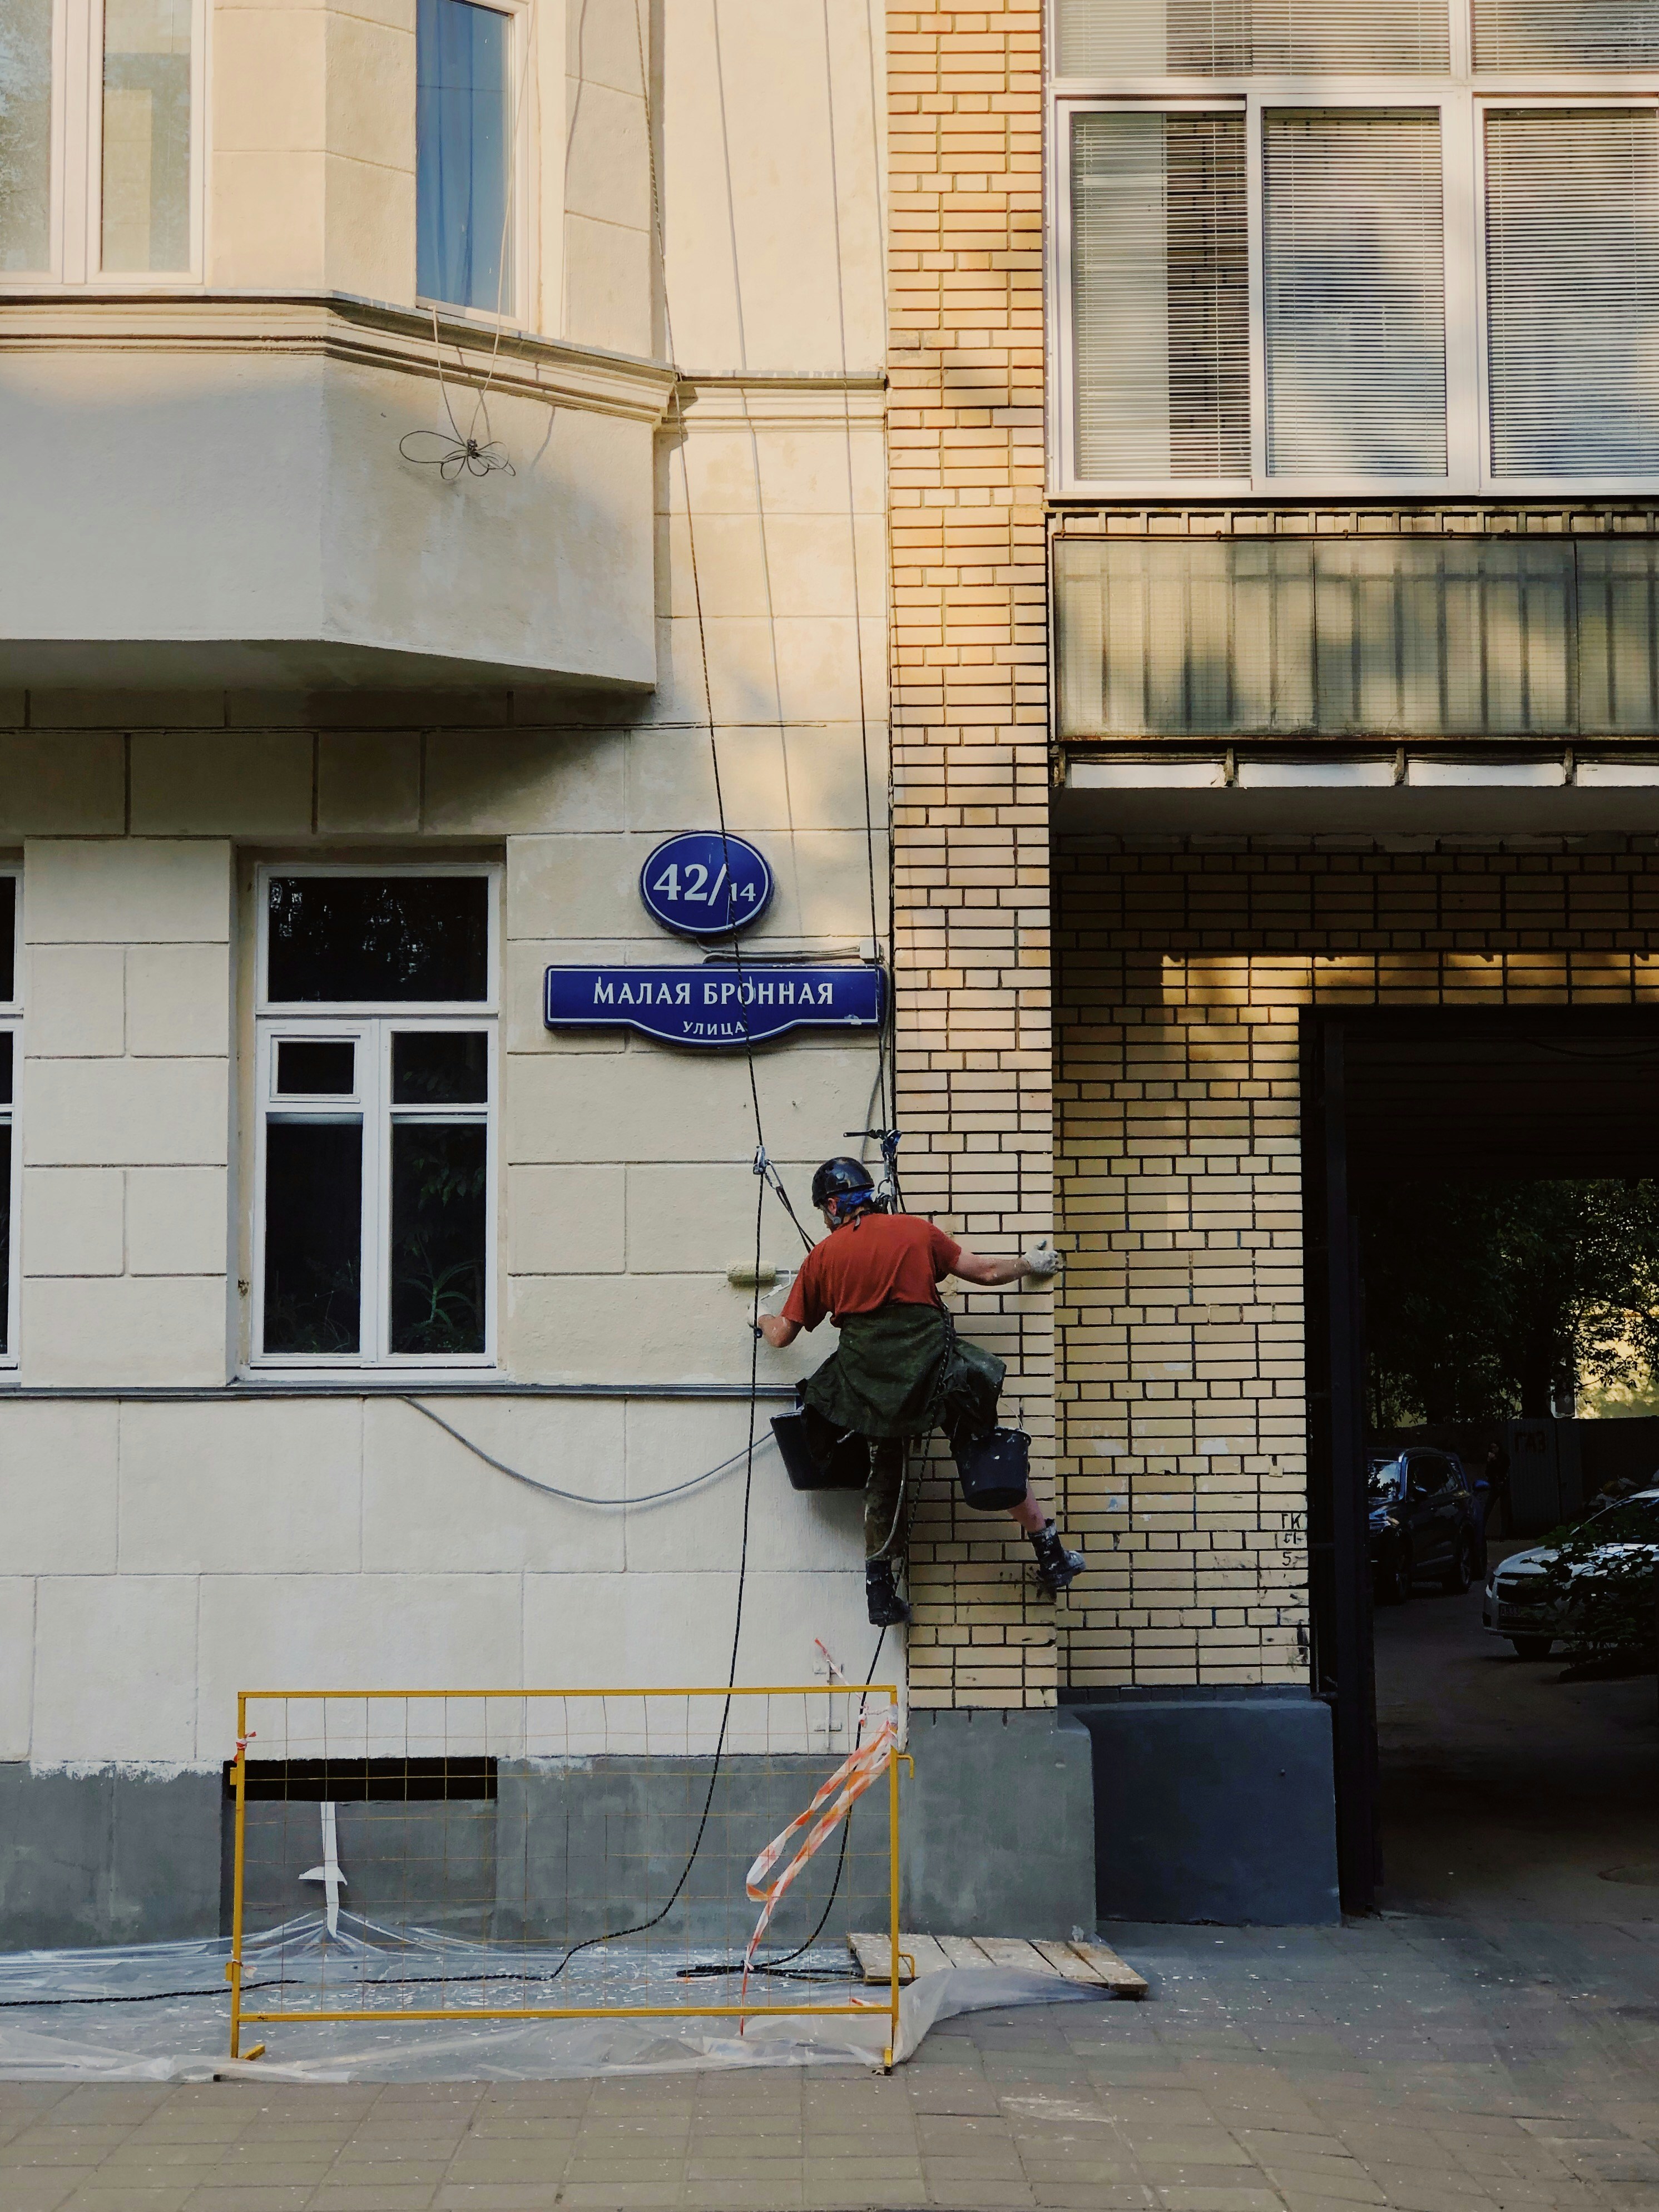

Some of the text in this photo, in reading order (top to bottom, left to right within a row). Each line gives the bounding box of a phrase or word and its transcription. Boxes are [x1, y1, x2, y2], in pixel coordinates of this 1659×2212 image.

[653, 863, 757, 905] 42/14
[593, 982, 833, 1004] МАЛАЯ БРОННАЯ
[683, 1021, 745, 1036] УЛИЦА
[1514, 1430, 1546, 1453] ГАЗ
